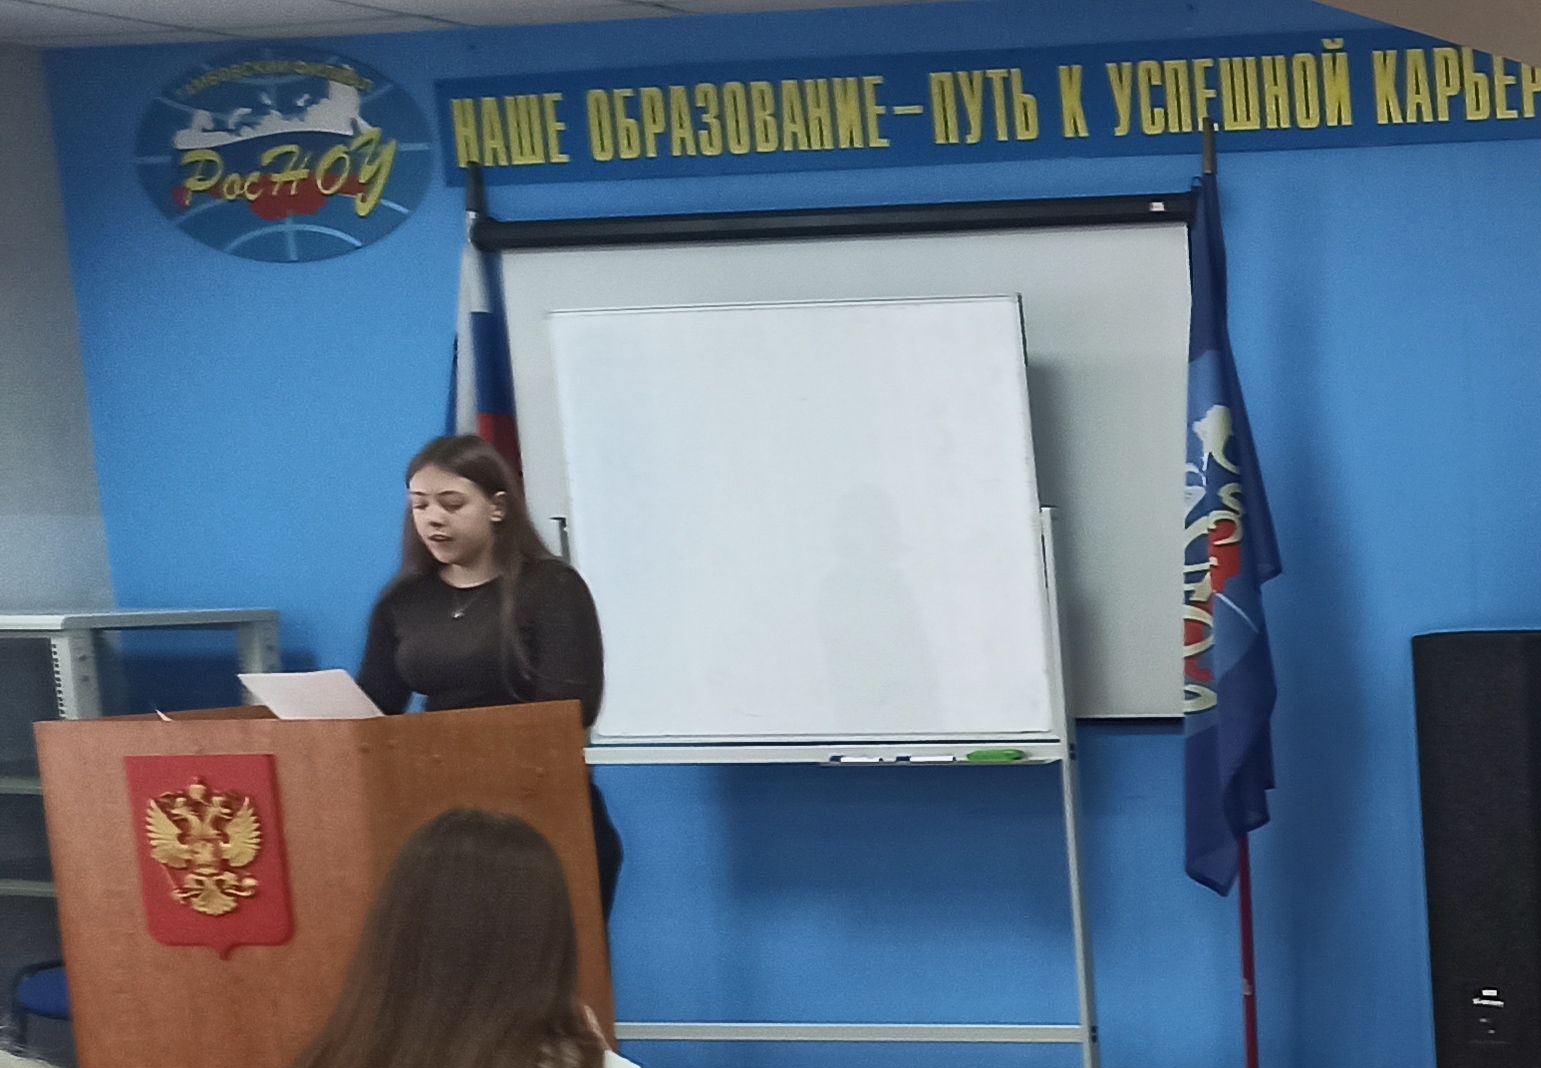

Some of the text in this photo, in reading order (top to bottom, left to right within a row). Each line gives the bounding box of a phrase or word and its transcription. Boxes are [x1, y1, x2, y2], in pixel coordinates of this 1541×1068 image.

[452, 93, 570, 168] НАШЕ
[1059, 65, 1089, 138] К
[1105, 38, 1353, 136] УСПЕШНОЙ
